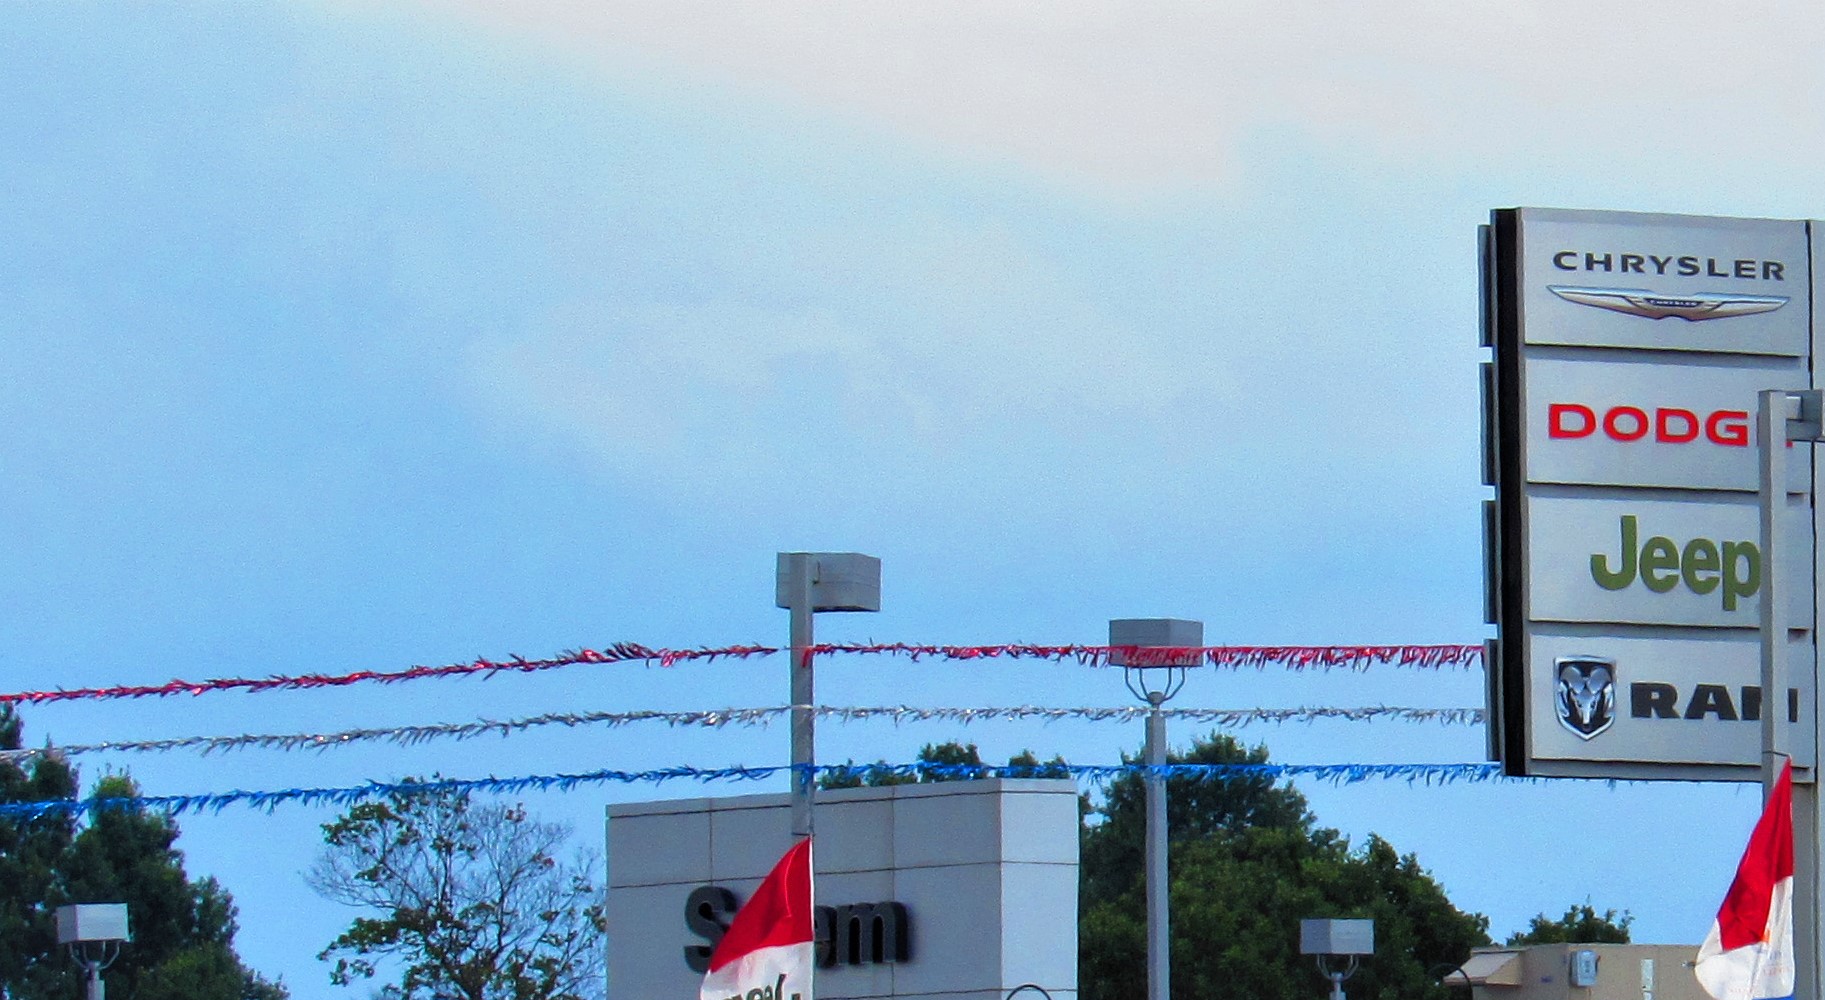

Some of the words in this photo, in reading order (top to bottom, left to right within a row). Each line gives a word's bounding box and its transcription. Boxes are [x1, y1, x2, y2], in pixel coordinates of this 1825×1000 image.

[1552, 250, 1786, 281] CHRYSLER
[1548, 403, 1793, 447] DODG
[1589, 515, 1761, 611] Jeep
